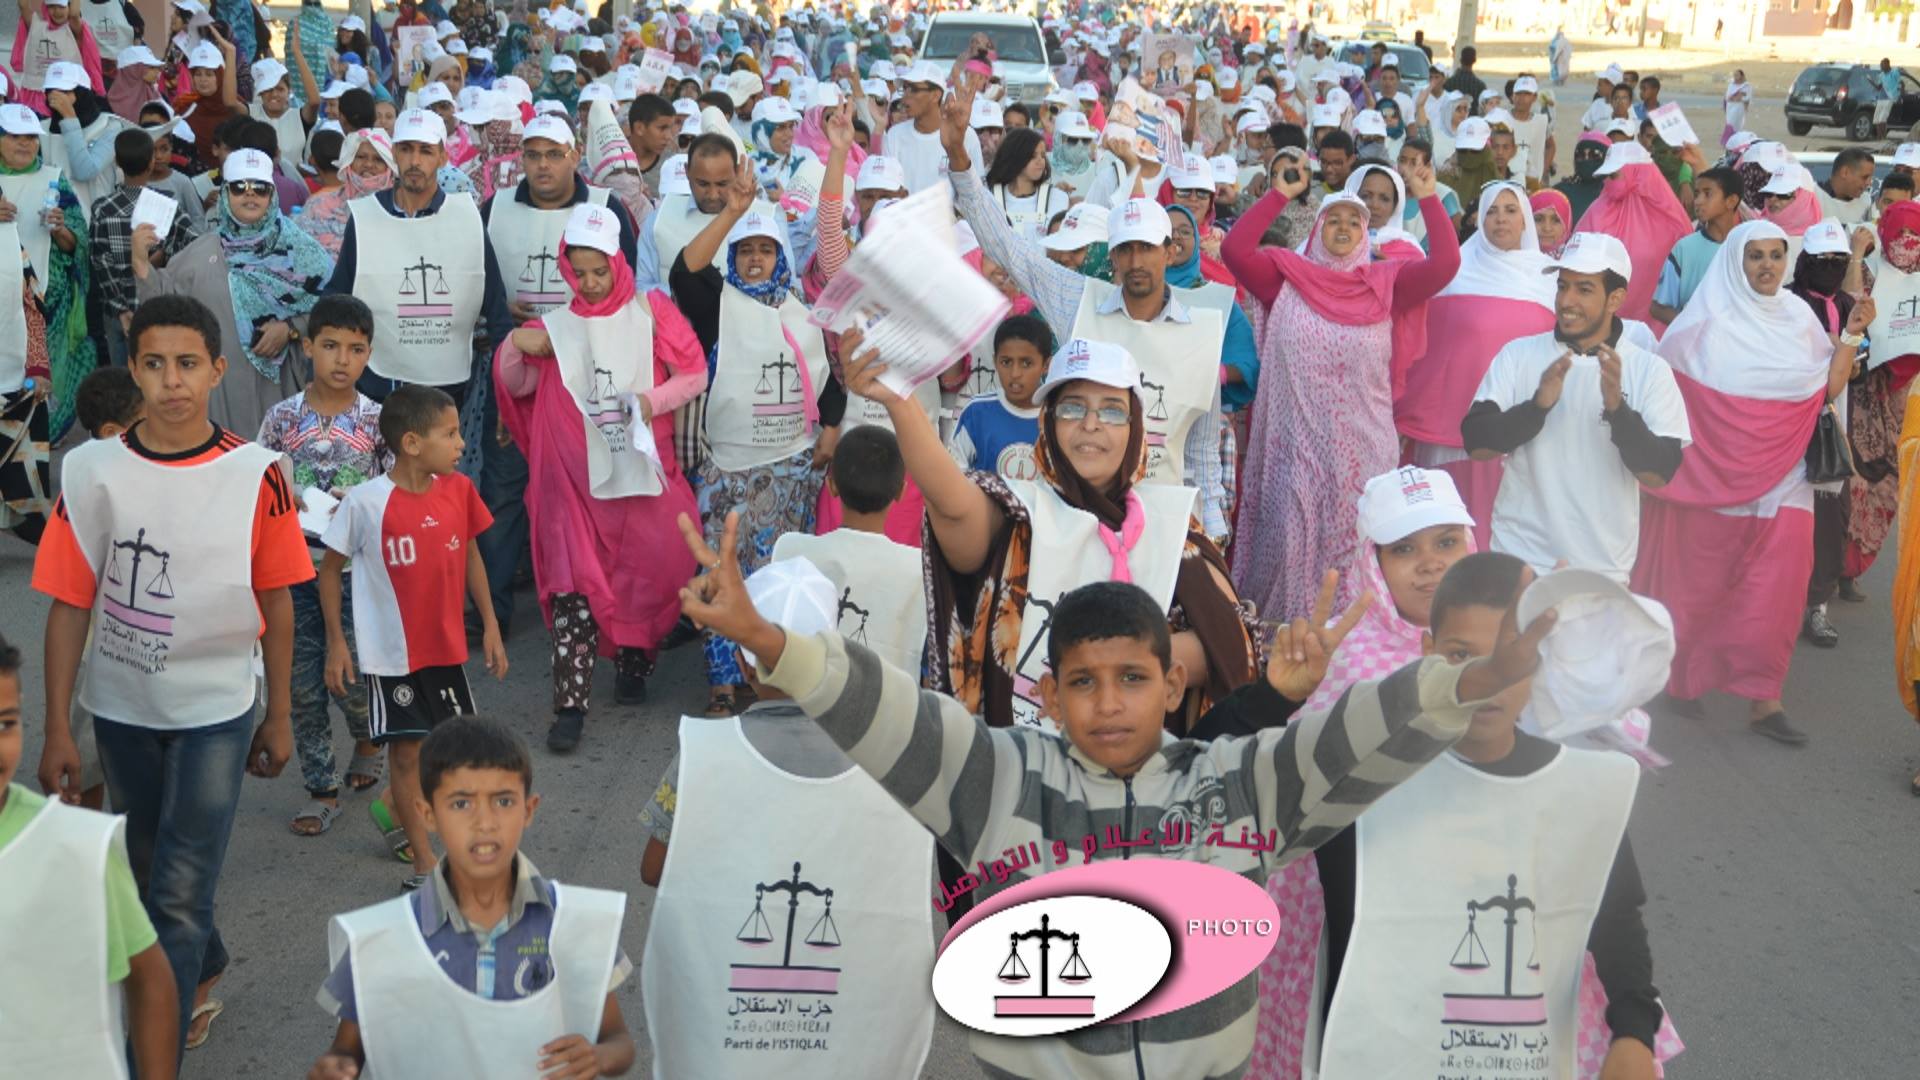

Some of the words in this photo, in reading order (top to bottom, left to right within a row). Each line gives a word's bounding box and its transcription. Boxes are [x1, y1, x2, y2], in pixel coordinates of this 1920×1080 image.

[387, 535, 417, 566] 10
[727, 996, 792, 1016] الاستقلال
[797, 999, 833, 1018] حزب
[724, 1037, 754, 1050] Parti
[755, 1037, 770, 1050] de
[772, 1038, 829, 1051] l'ISTIQLAL
[1440, 1028, 1518, 1051] الاستقلال
